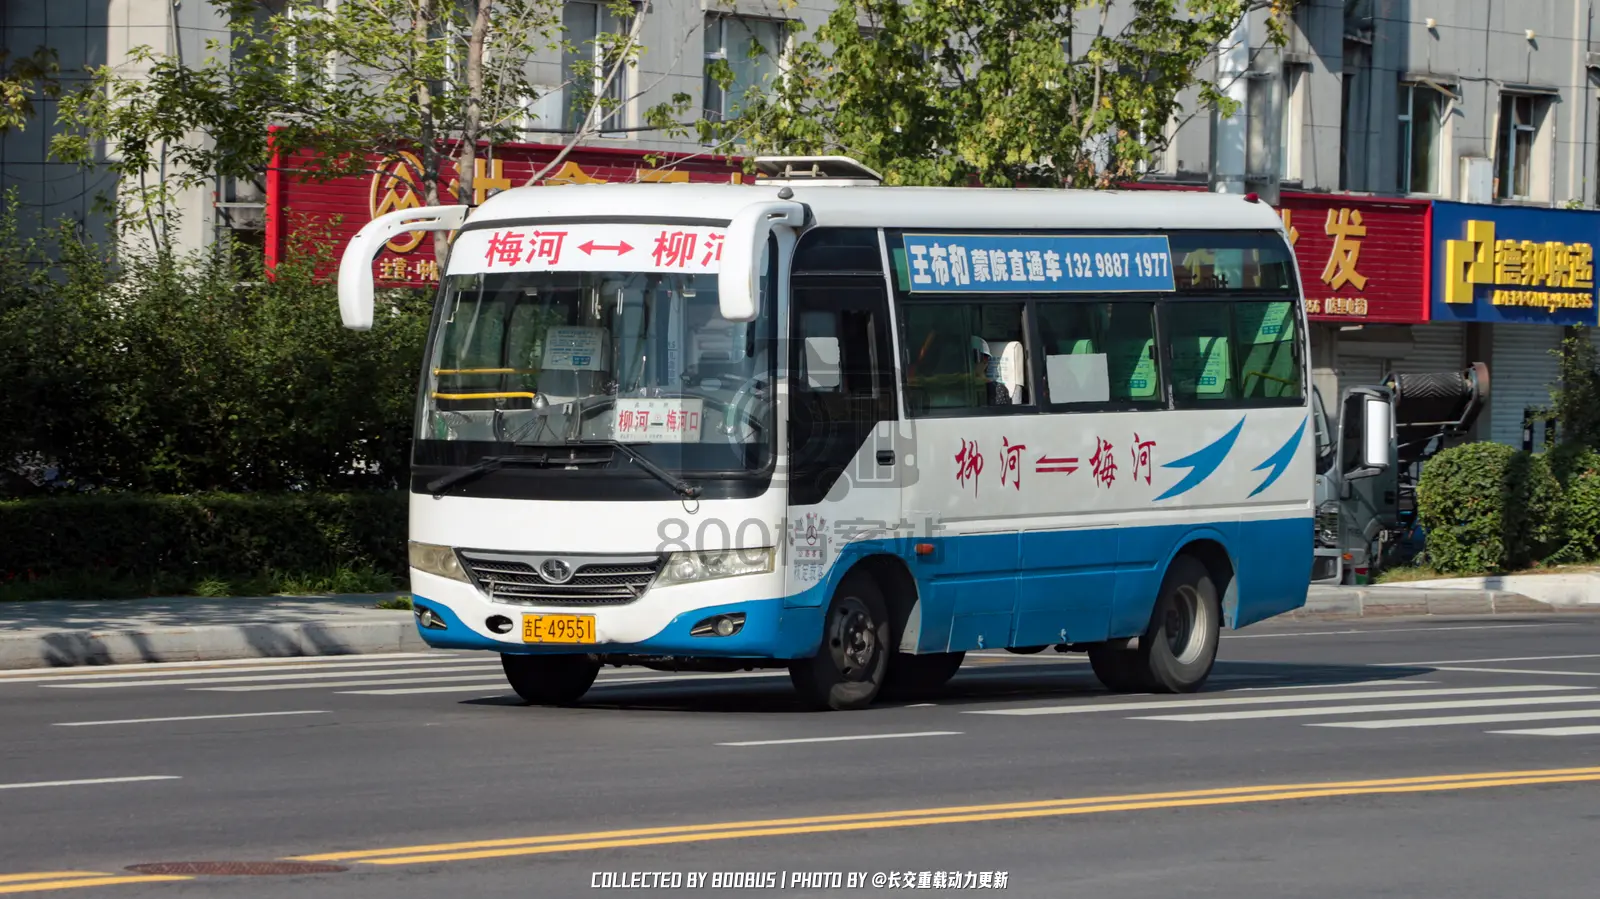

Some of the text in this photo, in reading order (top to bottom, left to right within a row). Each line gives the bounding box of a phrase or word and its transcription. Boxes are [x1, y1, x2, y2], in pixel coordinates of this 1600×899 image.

[485, 231, 568, 267] 梅河
[910, 243, 1168, 286] 王布和 蒙院直通车 132 9887 1977
[1494, 239, 1593, 288] 德邦快递
[955, 432, 1156, 499] 柳河 梅河
